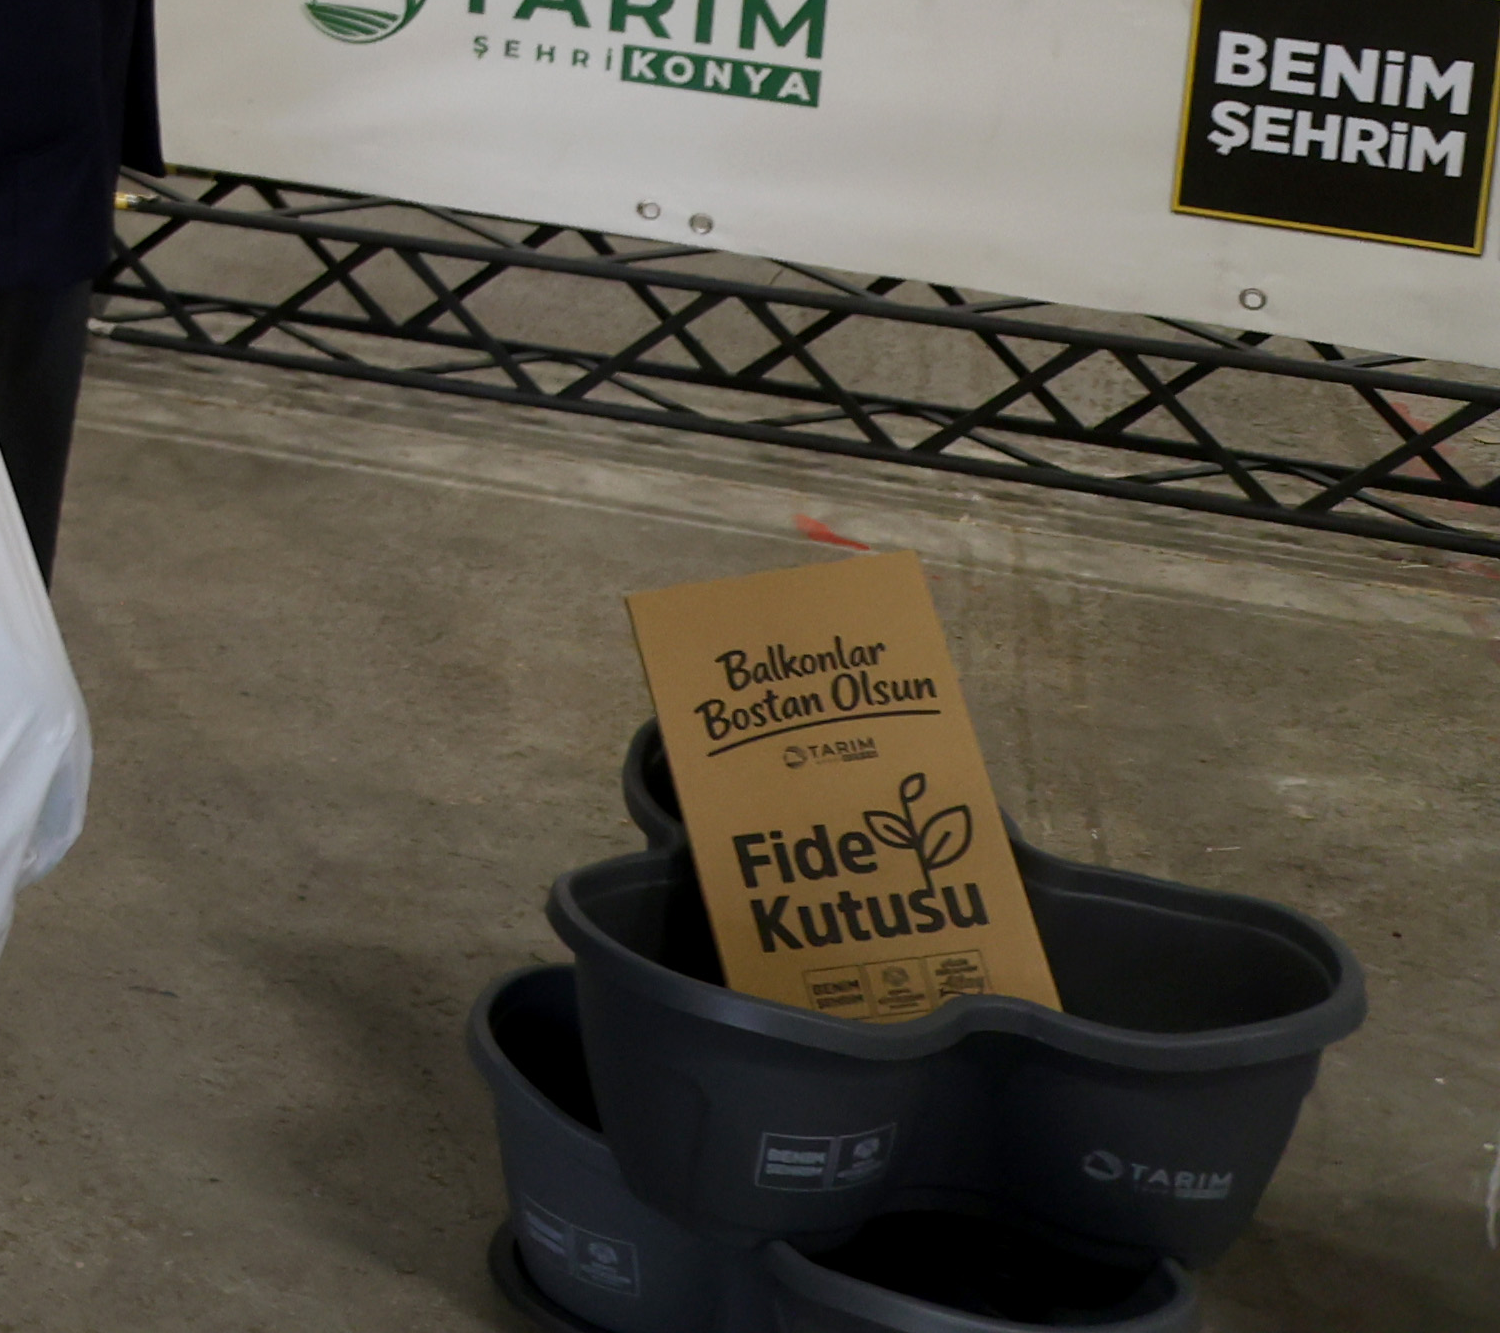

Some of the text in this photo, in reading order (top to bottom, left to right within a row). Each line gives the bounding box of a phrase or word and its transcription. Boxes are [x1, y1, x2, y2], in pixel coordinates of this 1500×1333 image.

[629, 48, 812, 103] KONYA
[714, 635, 887, 692] Balkonlar
[693, 672, 938, 741] Bostan Olsun
[806, 736, 877, 760] TARIM
[732, 824, 879, 889] Fide
[750, 882, 991, 953] Kutusu
